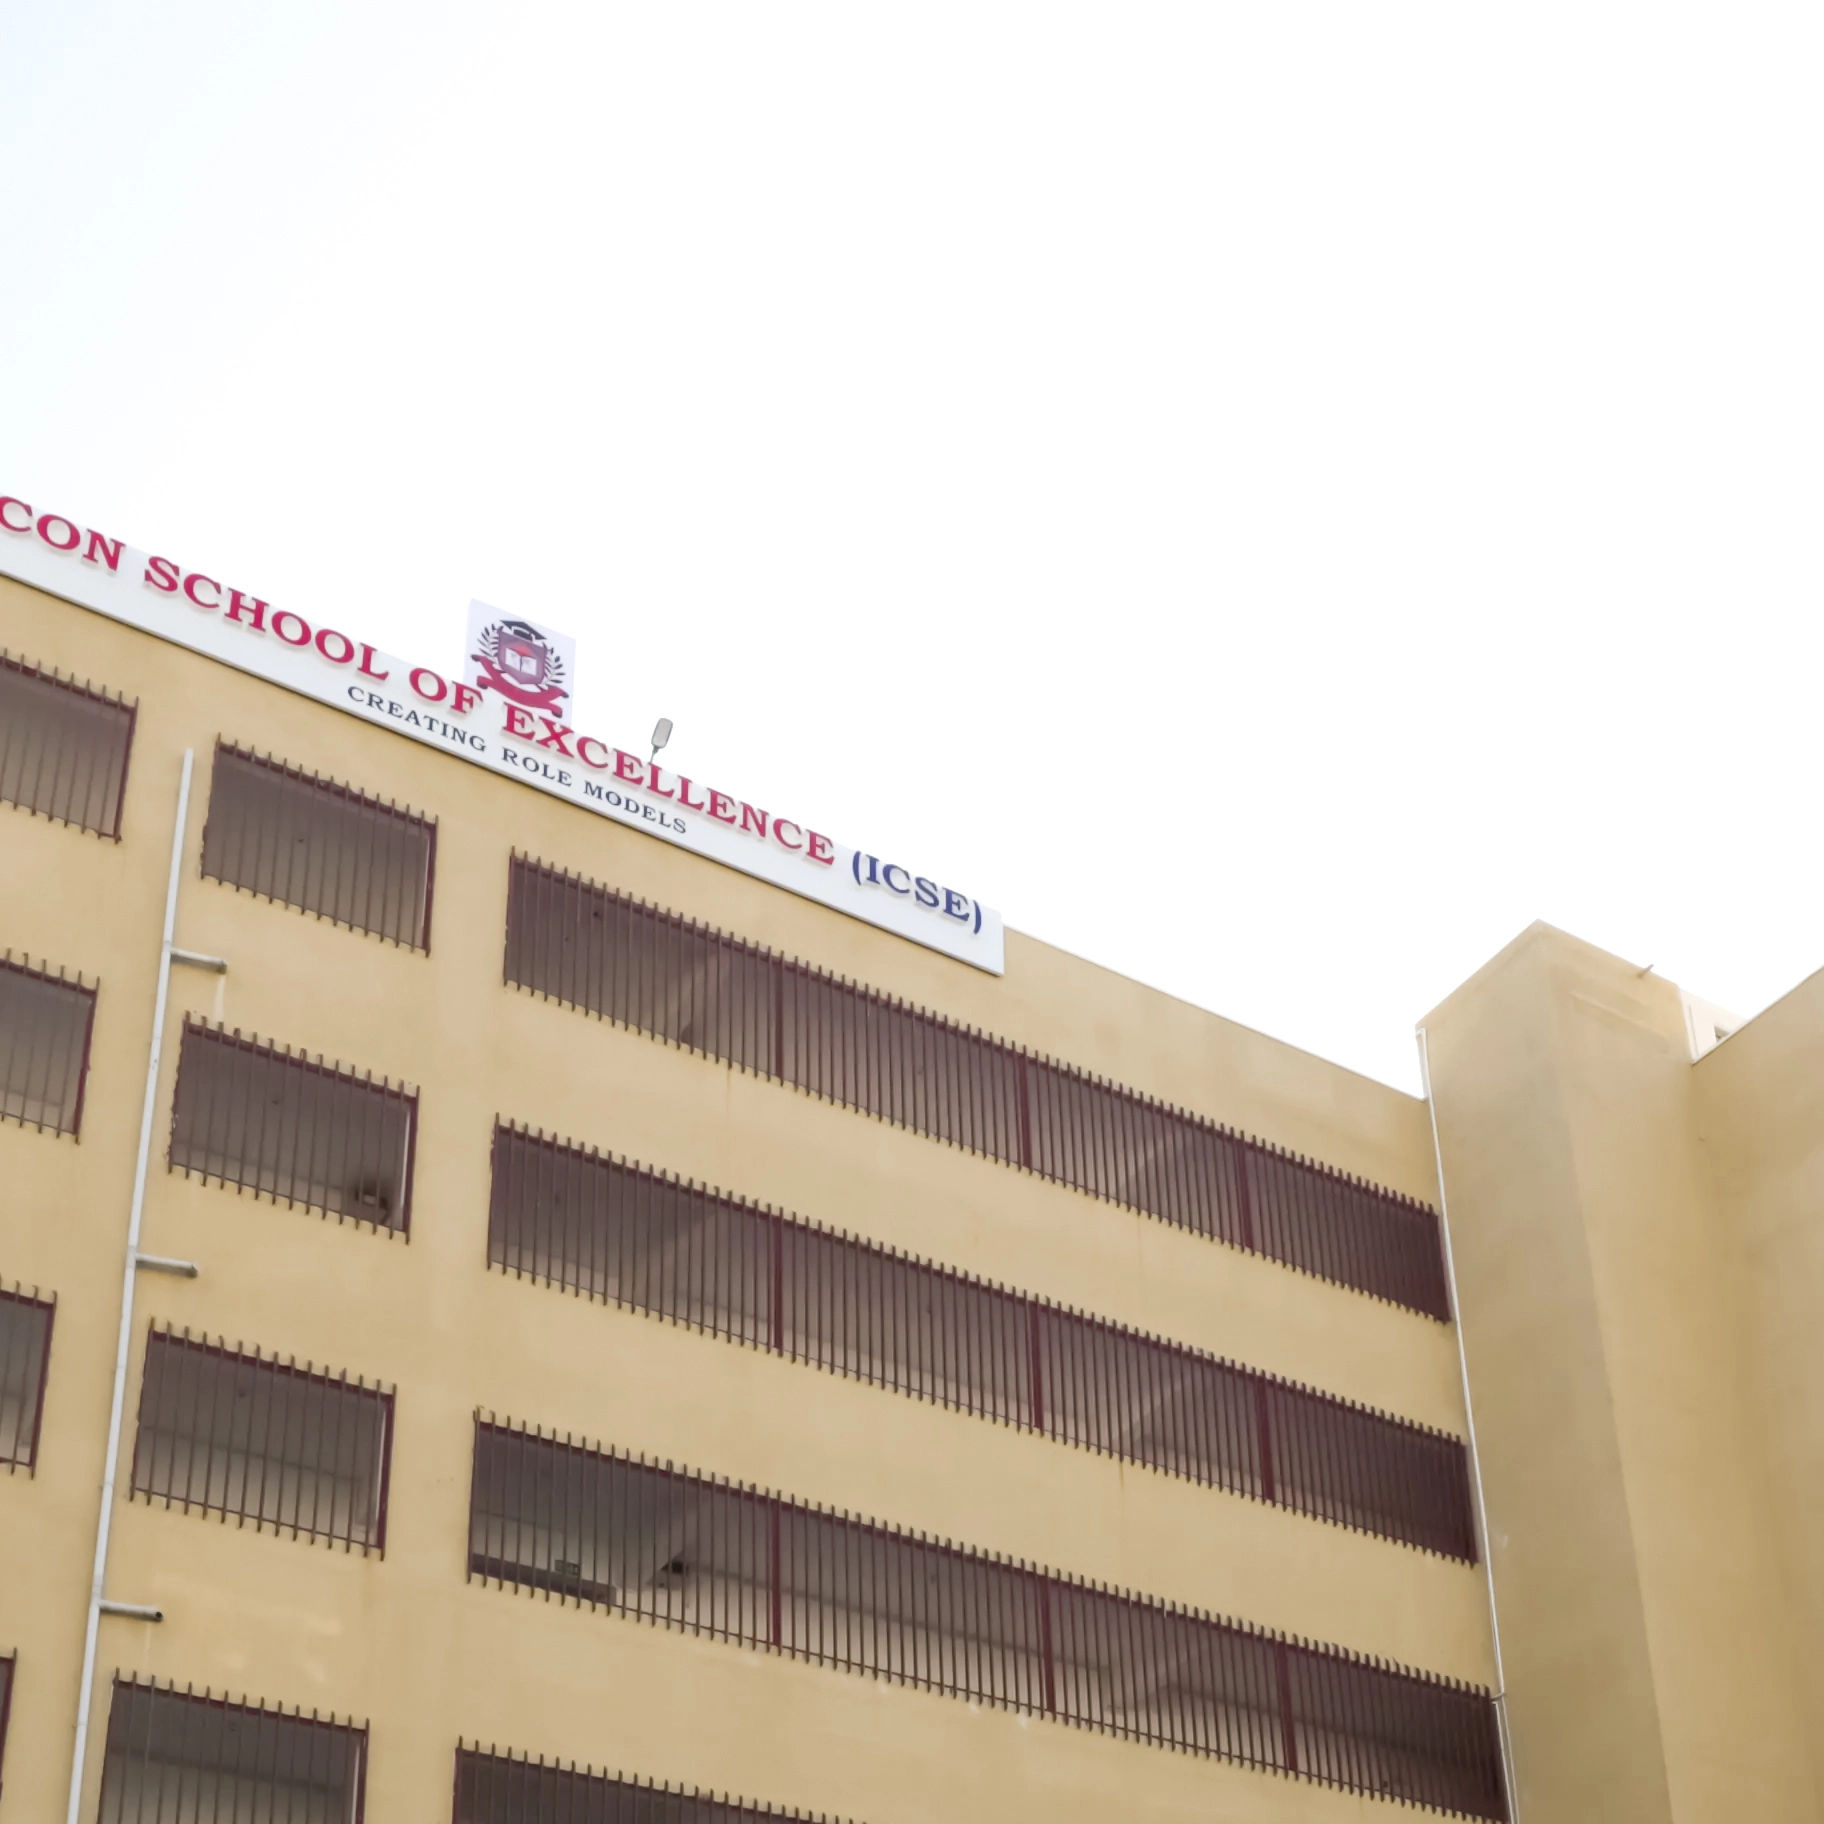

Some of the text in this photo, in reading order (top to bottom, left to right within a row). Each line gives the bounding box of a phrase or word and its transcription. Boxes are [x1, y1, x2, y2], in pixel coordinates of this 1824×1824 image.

[144, 555, 389, 682] SCHOOL
[408, 666, 483, 716] OF
[503, 702, 835, 866] EXCELLENCE
[851, 850, 983, 935] (ICSE)
[347, 685, 687, 835] CREATING ROLE MODELS
